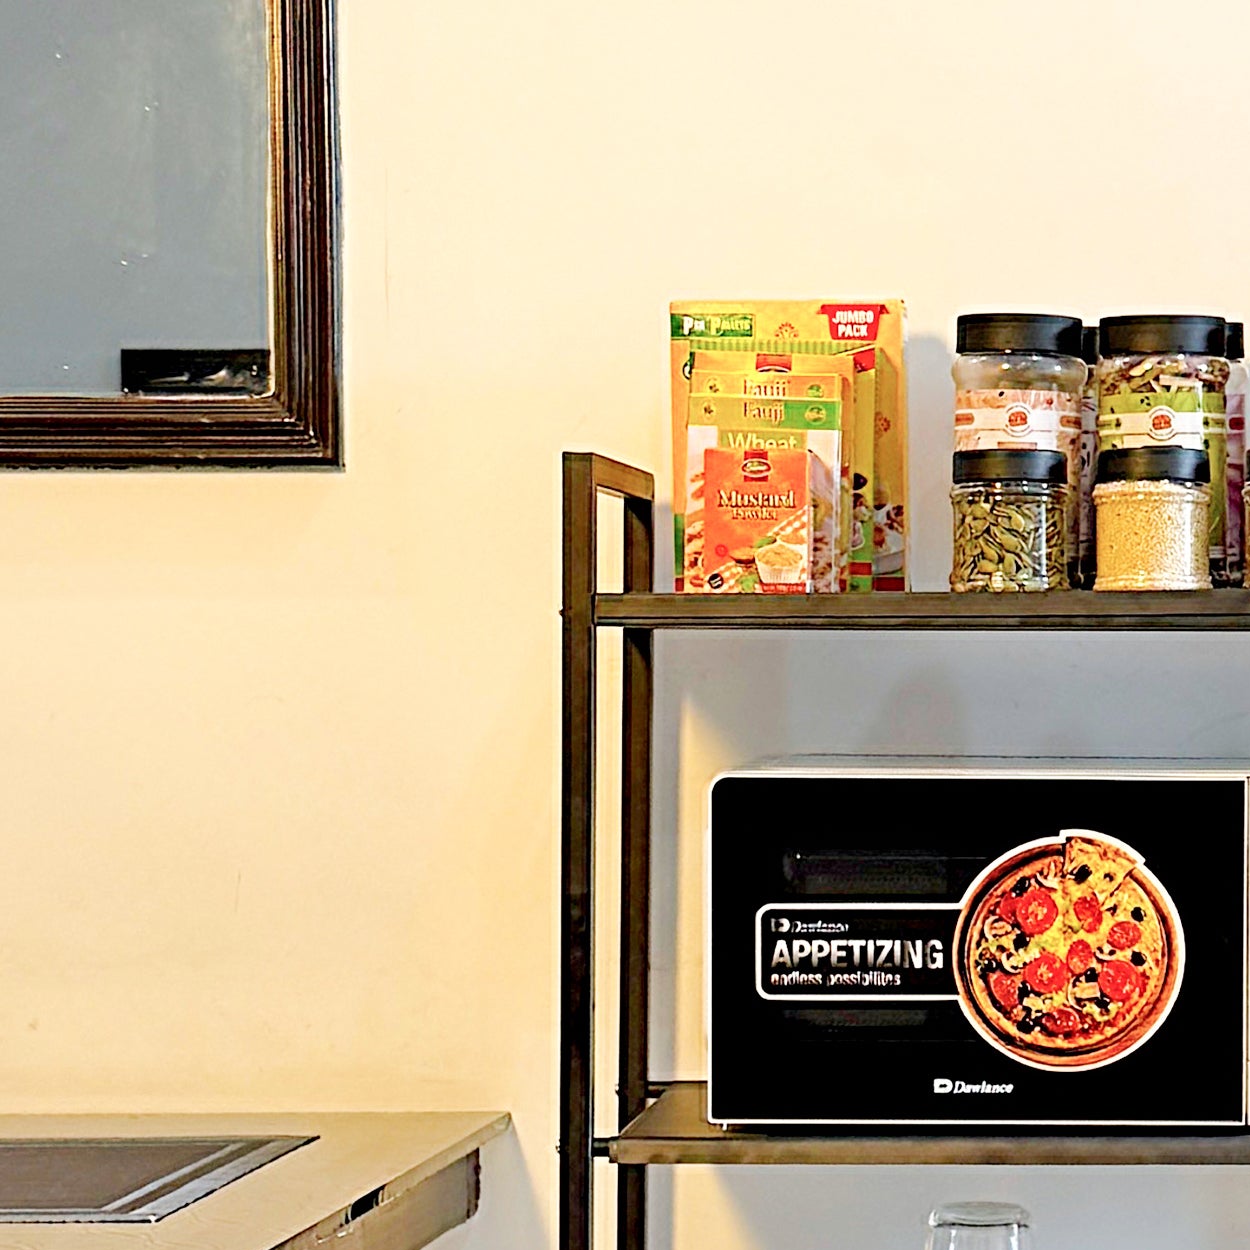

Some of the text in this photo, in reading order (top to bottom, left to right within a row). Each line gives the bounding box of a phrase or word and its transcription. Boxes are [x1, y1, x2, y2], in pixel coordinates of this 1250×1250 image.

[832, 310, 875, 324] JUMBO
[838, 324, 868, 338] PACK
[728, 432, 798, 448] Wheat
[718, 489, 796, 508] Mustard
[771, 939, 944, 969] APPETIZING
